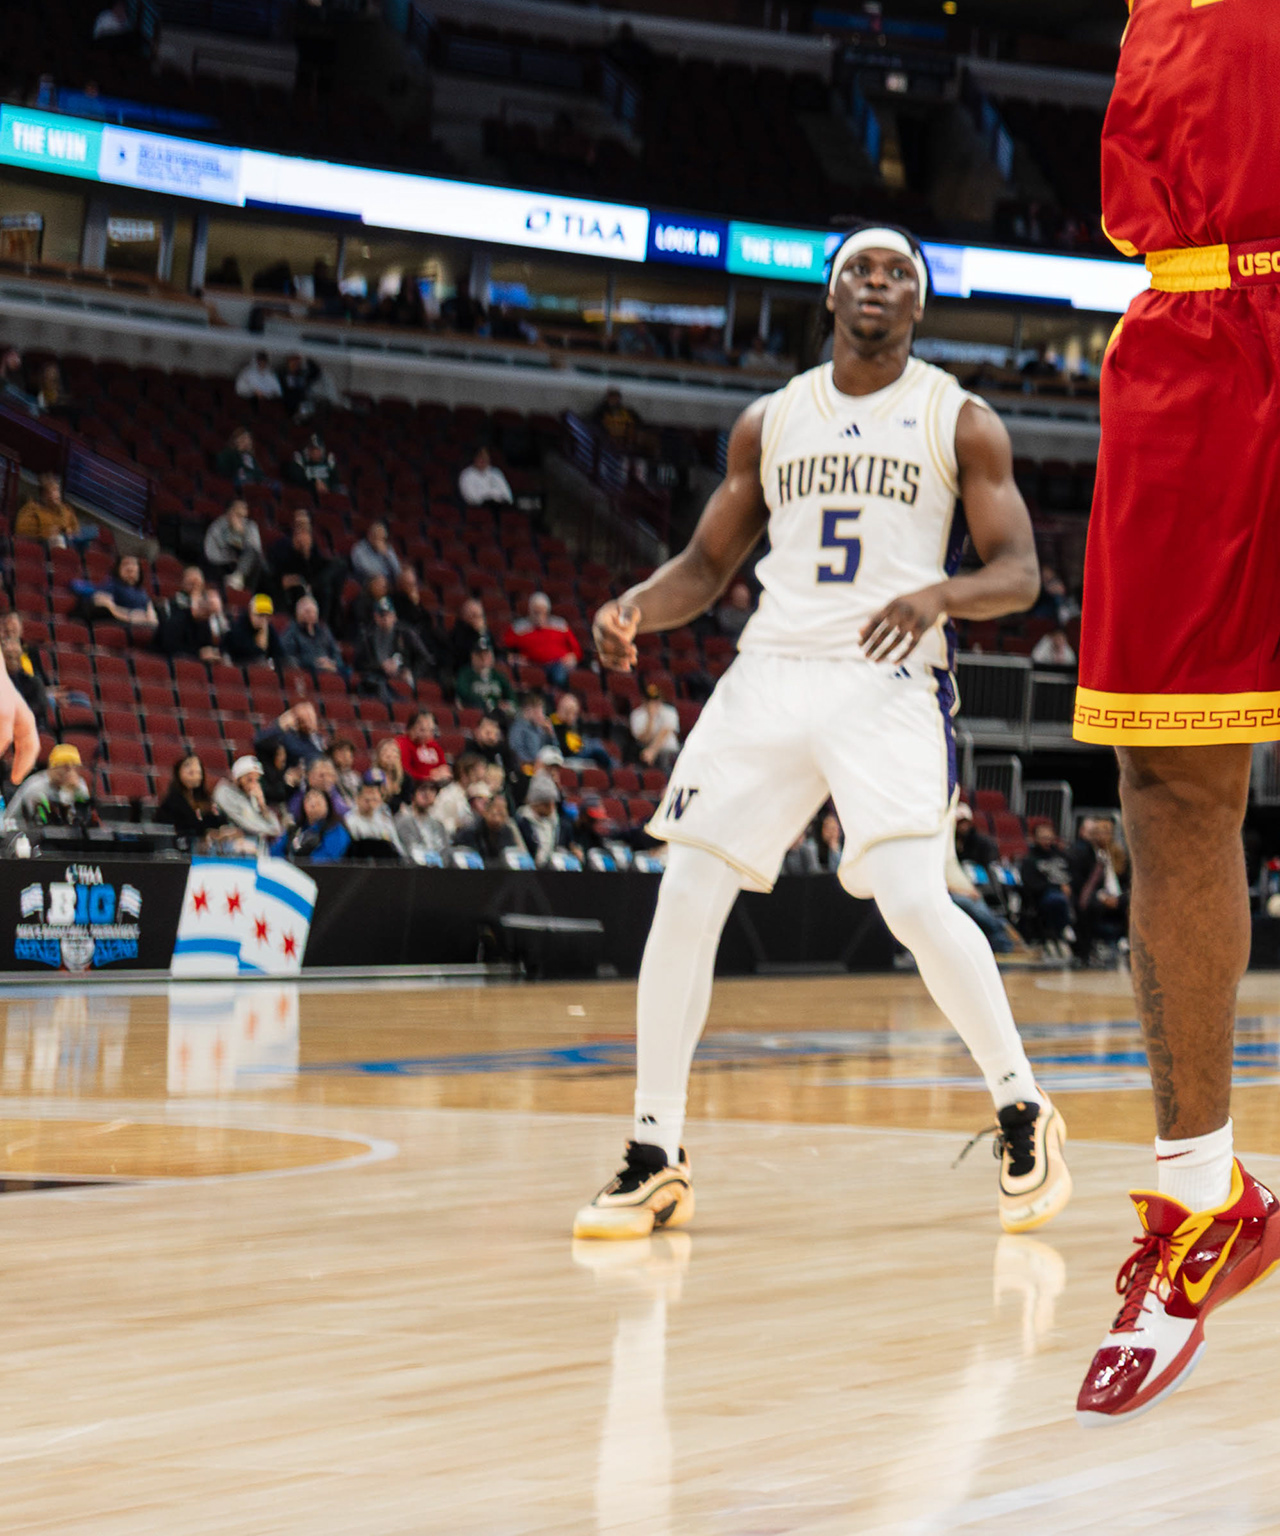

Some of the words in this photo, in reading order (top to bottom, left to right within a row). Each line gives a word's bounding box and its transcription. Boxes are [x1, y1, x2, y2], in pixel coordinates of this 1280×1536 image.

[12, 120, 47, 156] THE
[46, 127, 88, 163] WIN
[563, 214, 627, 243] TIAA
[654, 222, 699, 256] LOCK
[697, 228, 721, 259] IN
[776, 451, 922, 506] HUSKIES
[815, 506, 866, 586] 5
